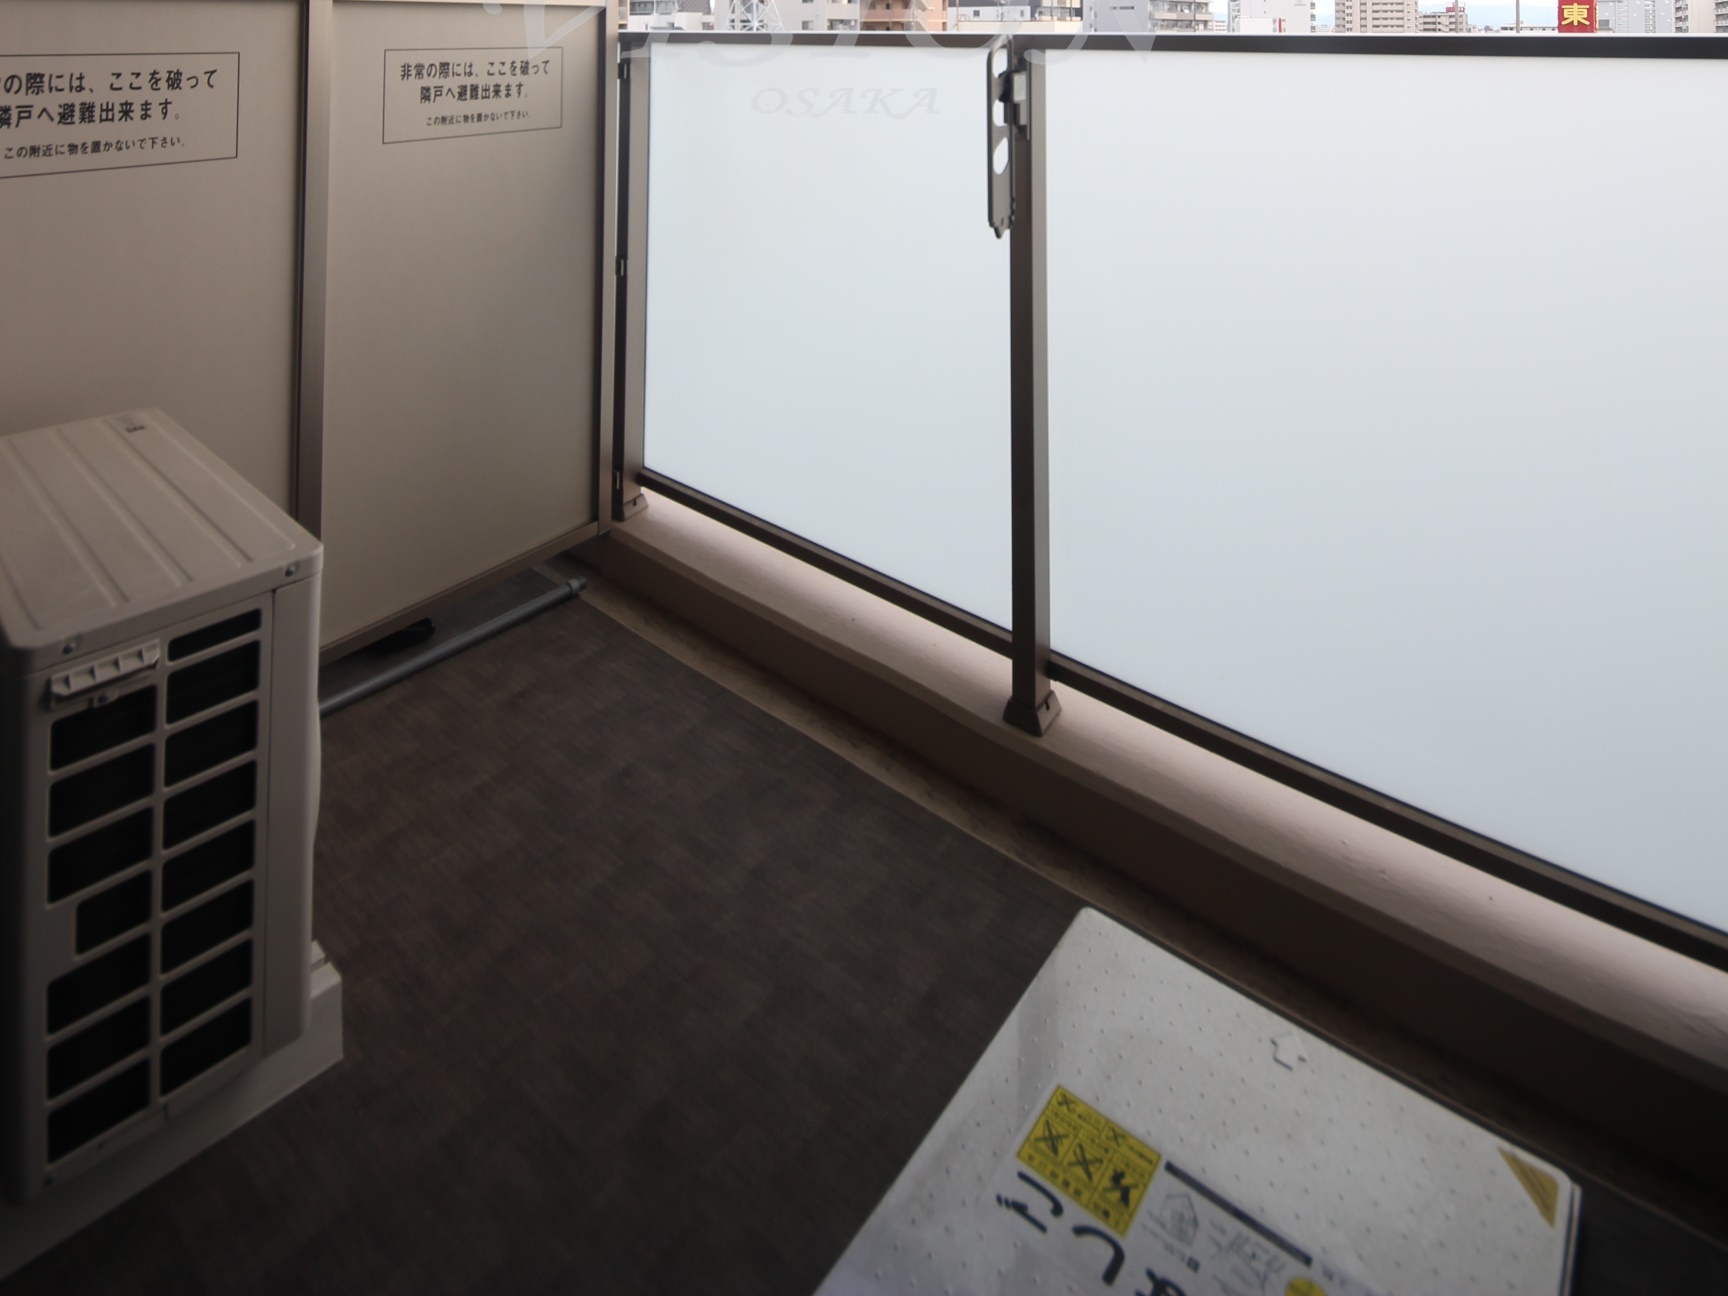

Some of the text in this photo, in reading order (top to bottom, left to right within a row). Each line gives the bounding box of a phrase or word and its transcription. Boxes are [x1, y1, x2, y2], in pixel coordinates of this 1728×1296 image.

[1561, 2, 1590, 26] 東
[400, 59, 551, 81] 非常の際には、ここを破って
[0, 69, 218, 97] の際には、ここを破って
